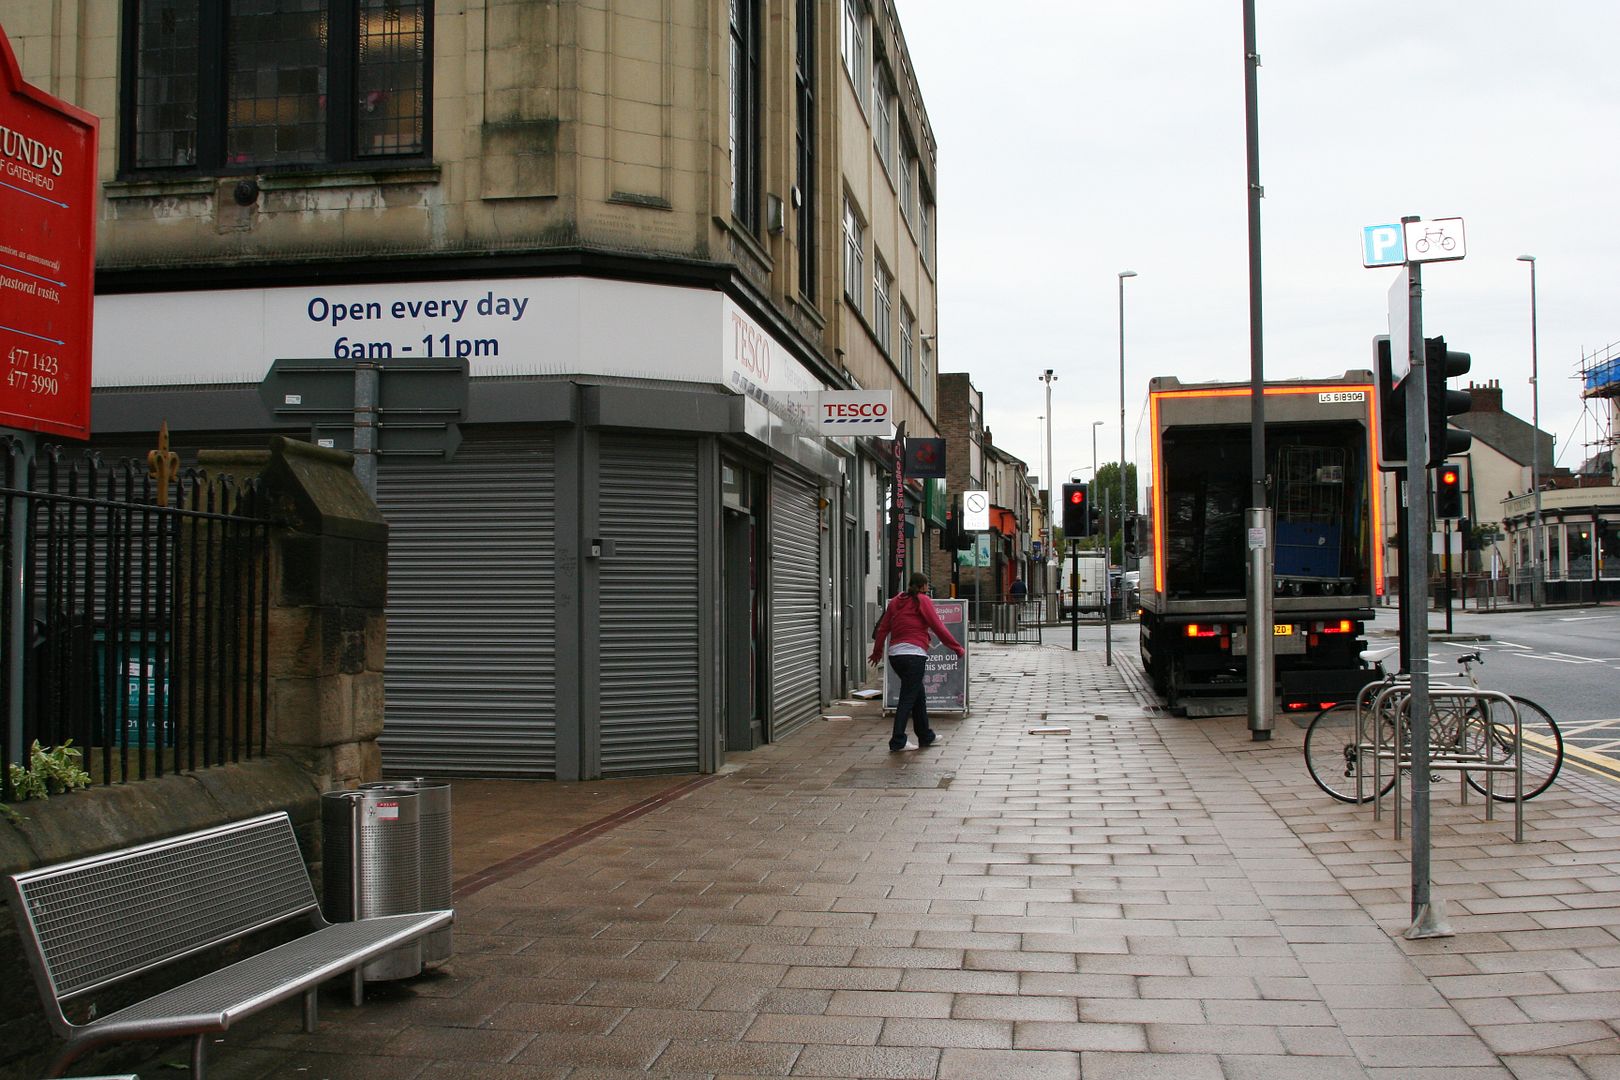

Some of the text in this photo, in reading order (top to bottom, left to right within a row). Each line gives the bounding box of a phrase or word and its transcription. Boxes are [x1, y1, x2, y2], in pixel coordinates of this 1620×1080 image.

[0, 126, 62, 176] UND'S
[7, 162, 54, 190] GATESHEAD
[1372, 227, 1397, 260] P
[0, 275, 37, 295] pastoral
[307, 291, 529, 327] Open every day
[334, 336, 393, 359] 6am
[422, 333, 499, 358] 11pm
[732, 310, 771, 384] TESCO
[8, 346, 58, 376] 477 1423
[8, 368, 58, 396] 477 3990
[823, 403, 888, 417] TESCO
